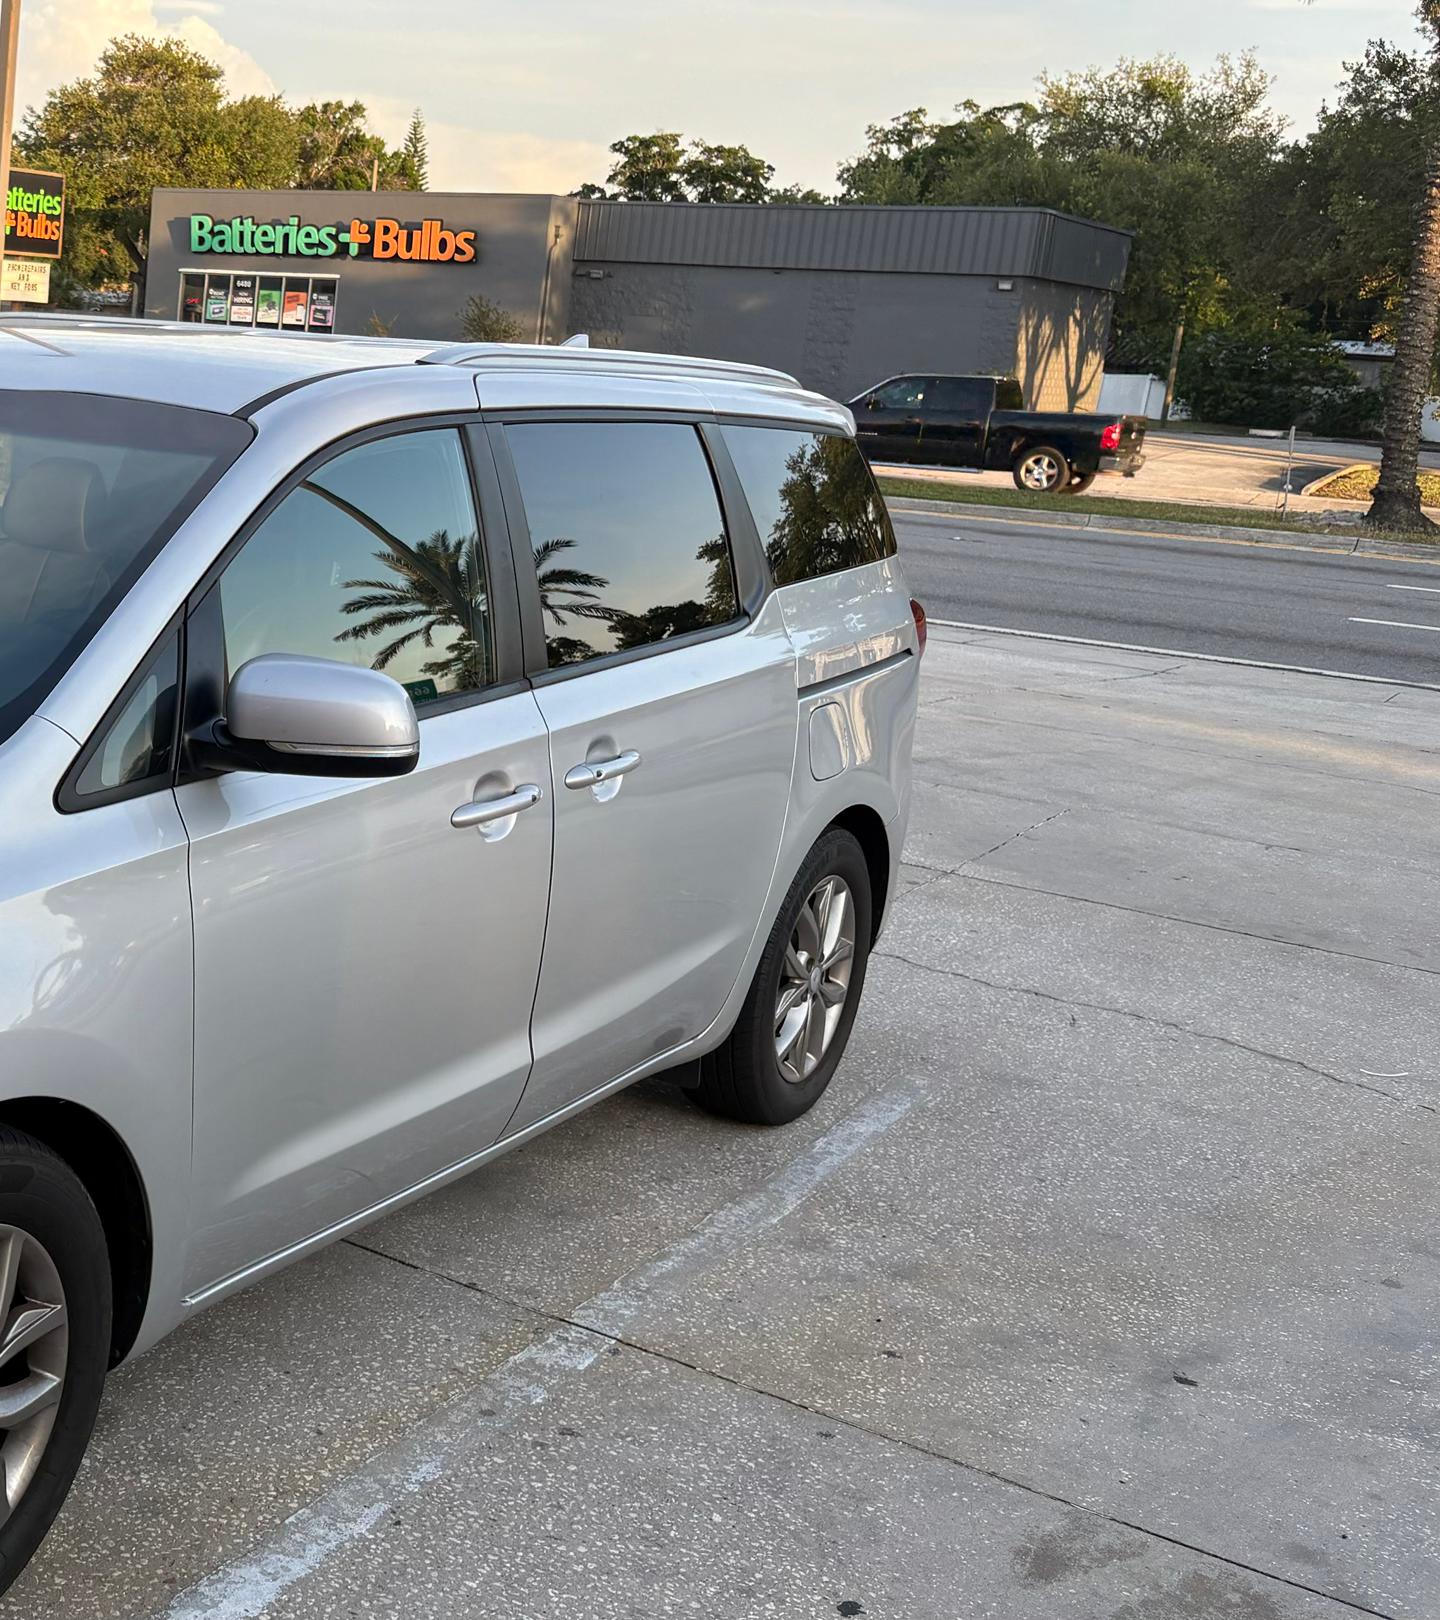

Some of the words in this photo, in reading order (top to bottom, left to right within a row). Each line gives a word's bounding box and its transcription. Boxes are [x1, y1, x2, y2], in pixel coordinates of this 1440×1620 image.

[6, 186, 62, 216] atteries
[16, 211, 60, 240] Bulbs
[190, 215, 338, 257] Batteries
[372, 218, 475, 262] Bulbs
[233, 296, 254, 304] HIRING
